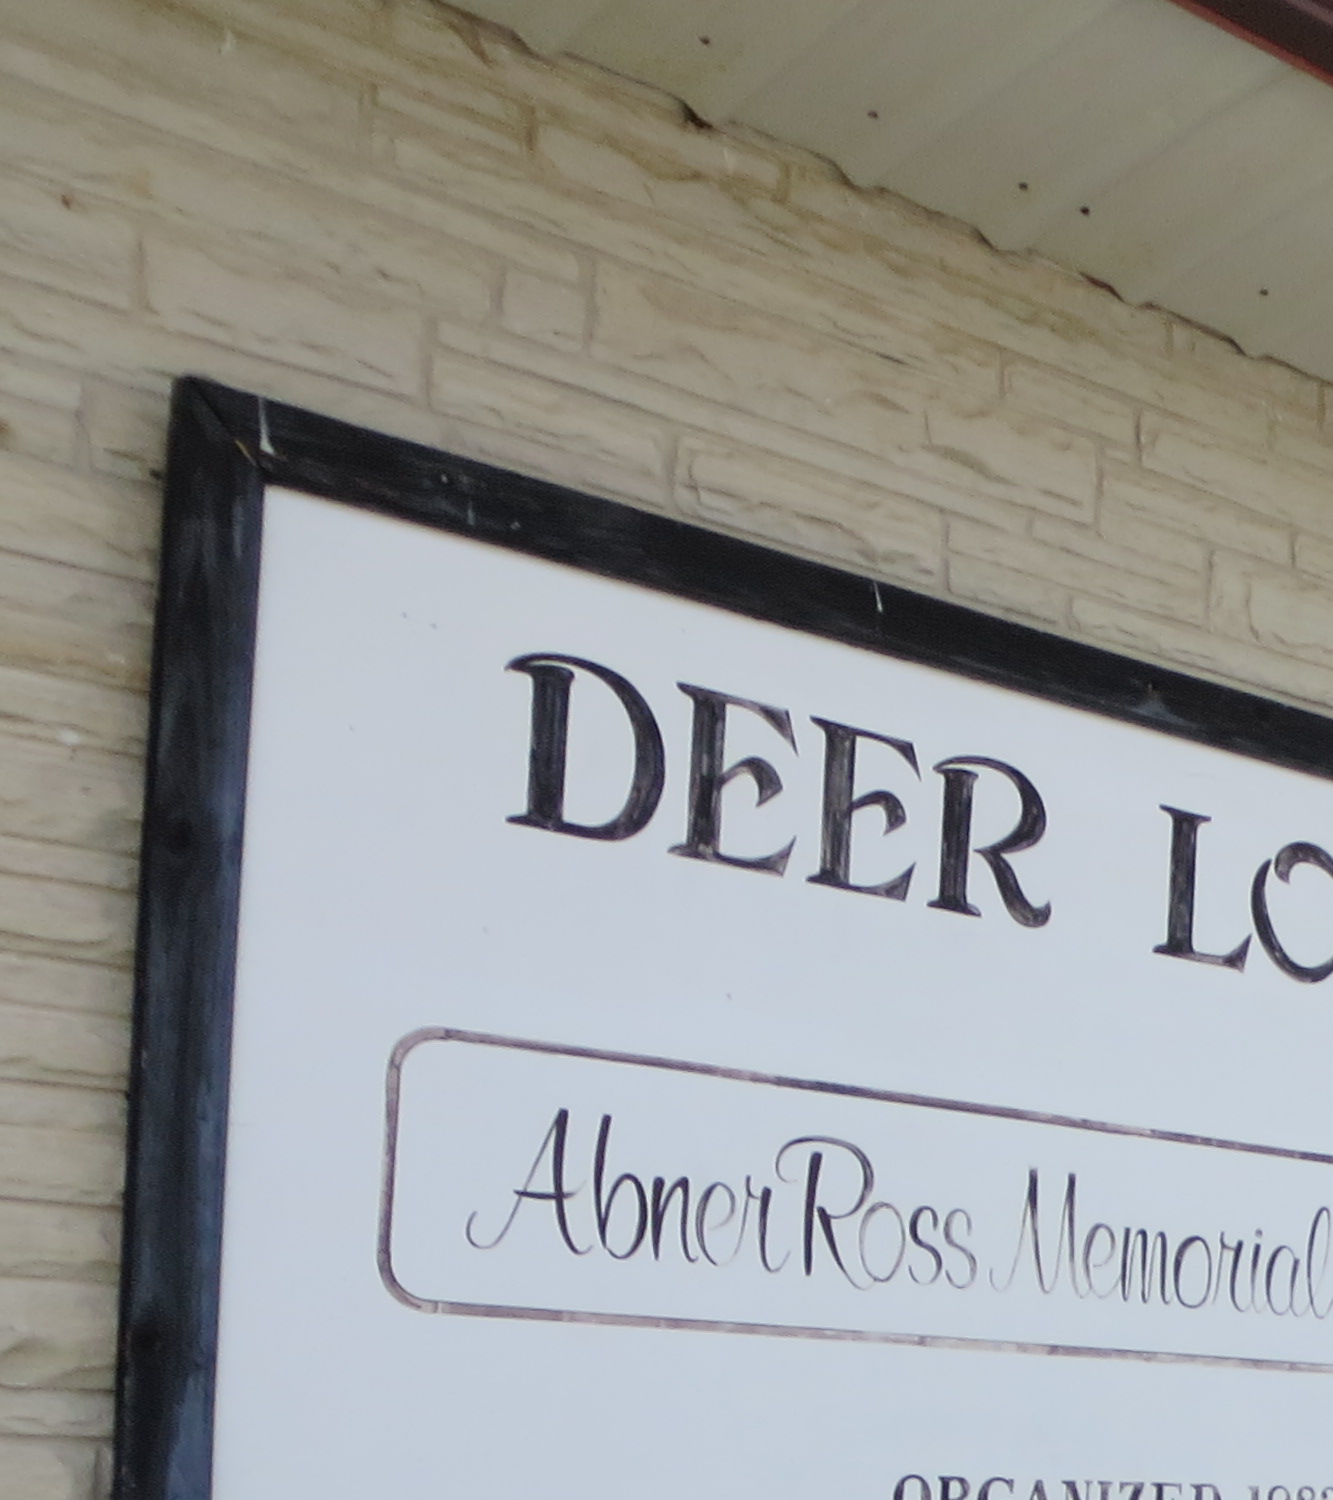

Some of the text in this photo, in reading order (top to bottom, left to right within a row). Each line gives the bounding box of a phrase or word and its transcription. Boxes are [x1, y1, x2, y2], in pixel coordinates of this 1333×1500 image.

[504, 651, 1052, 929] DEER
[466, 1108, 790, 1274] Abner
[774, 1135, 978, 1291] Ross
